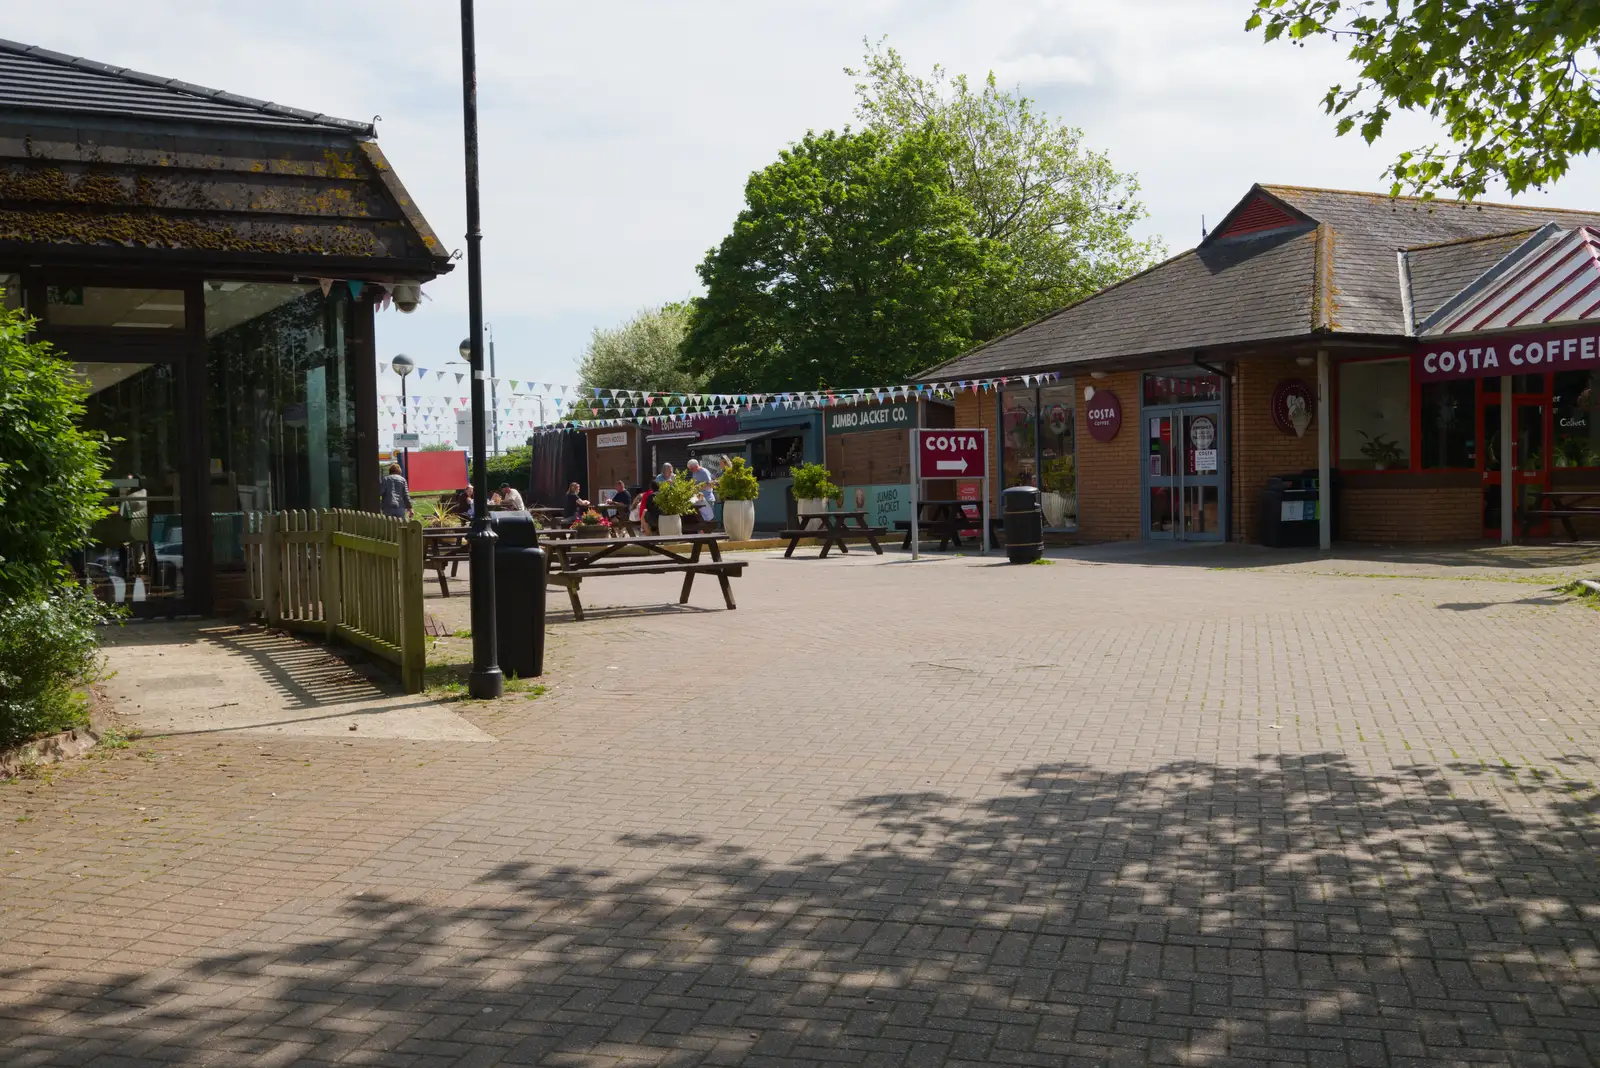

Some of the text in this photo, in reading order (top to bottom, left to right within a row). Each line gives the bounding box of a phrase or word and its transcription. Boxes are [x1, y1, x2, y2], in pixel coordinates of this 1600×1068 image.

[1424, 336, 1600, 373] COSTA COFFE
[832, 407, 907, 428] JUMBO JACKET CO.
[1088, 408, 1115, 419] COSTA
[675, 419, 693, 429] COFFEE
[926, 437, 977, 452] COSTA
[877, 489, 898, 503] JUMBO
[877, 500, 900, 514] JACKET
[878, 515, 889, 526] CO.
